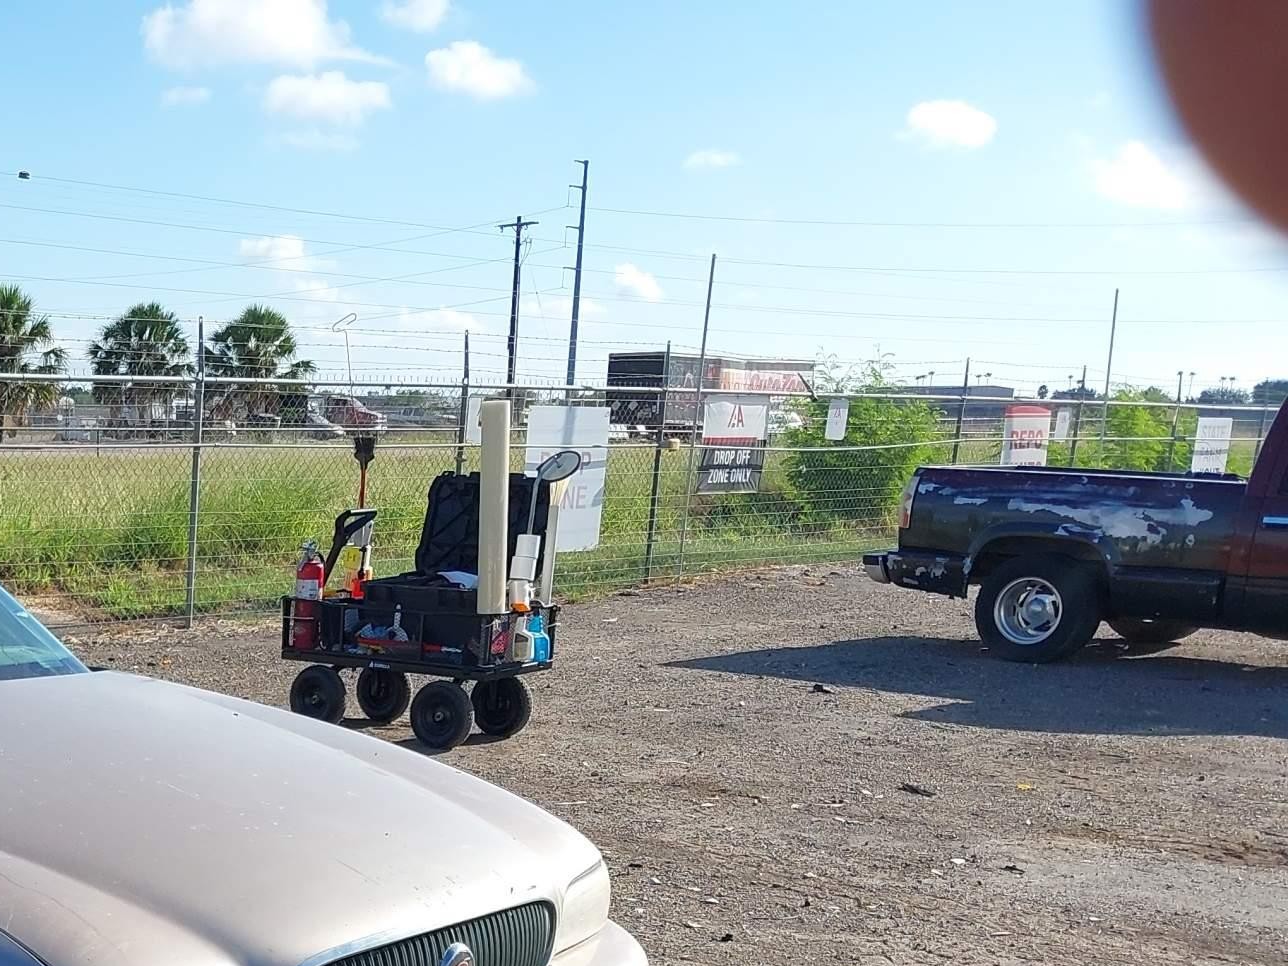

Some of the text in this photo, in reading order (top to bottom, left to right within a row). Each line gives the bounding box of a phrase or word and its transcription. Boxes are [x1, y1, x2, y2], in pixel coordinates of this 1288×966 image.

[1009, 430, 1044, 449] REPO
[714, 450, 751, 465] DROP OFF
[707, 467, 752, 483] ZONE ONLY
